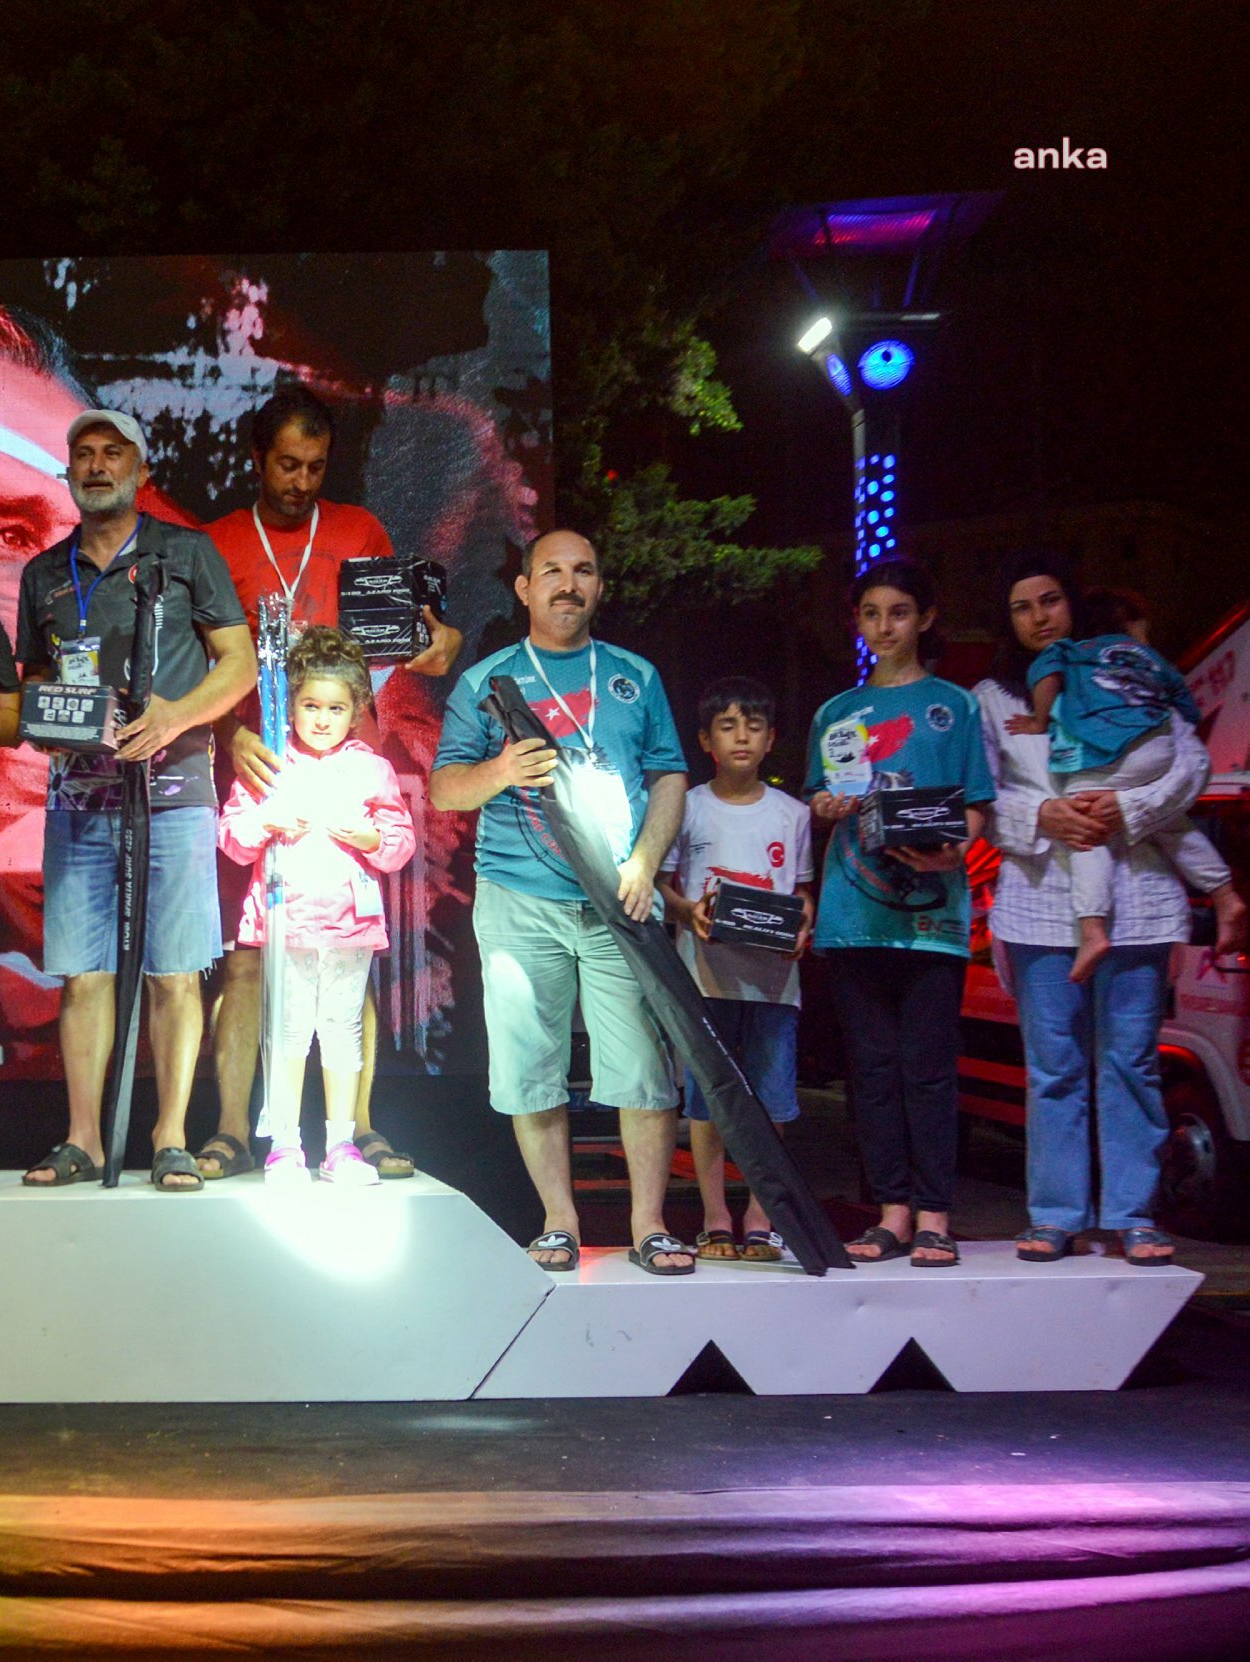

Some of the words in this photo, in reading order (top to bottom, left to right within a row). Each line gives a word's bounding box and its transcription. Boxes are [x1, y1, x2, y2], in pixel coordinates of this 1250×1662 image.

[38, 685, 63, 693] RED
[64, 687, 98, 695] SURF
[124, 854, 133, 879] SURF
[124, 881, 132, 918] SPARTA
